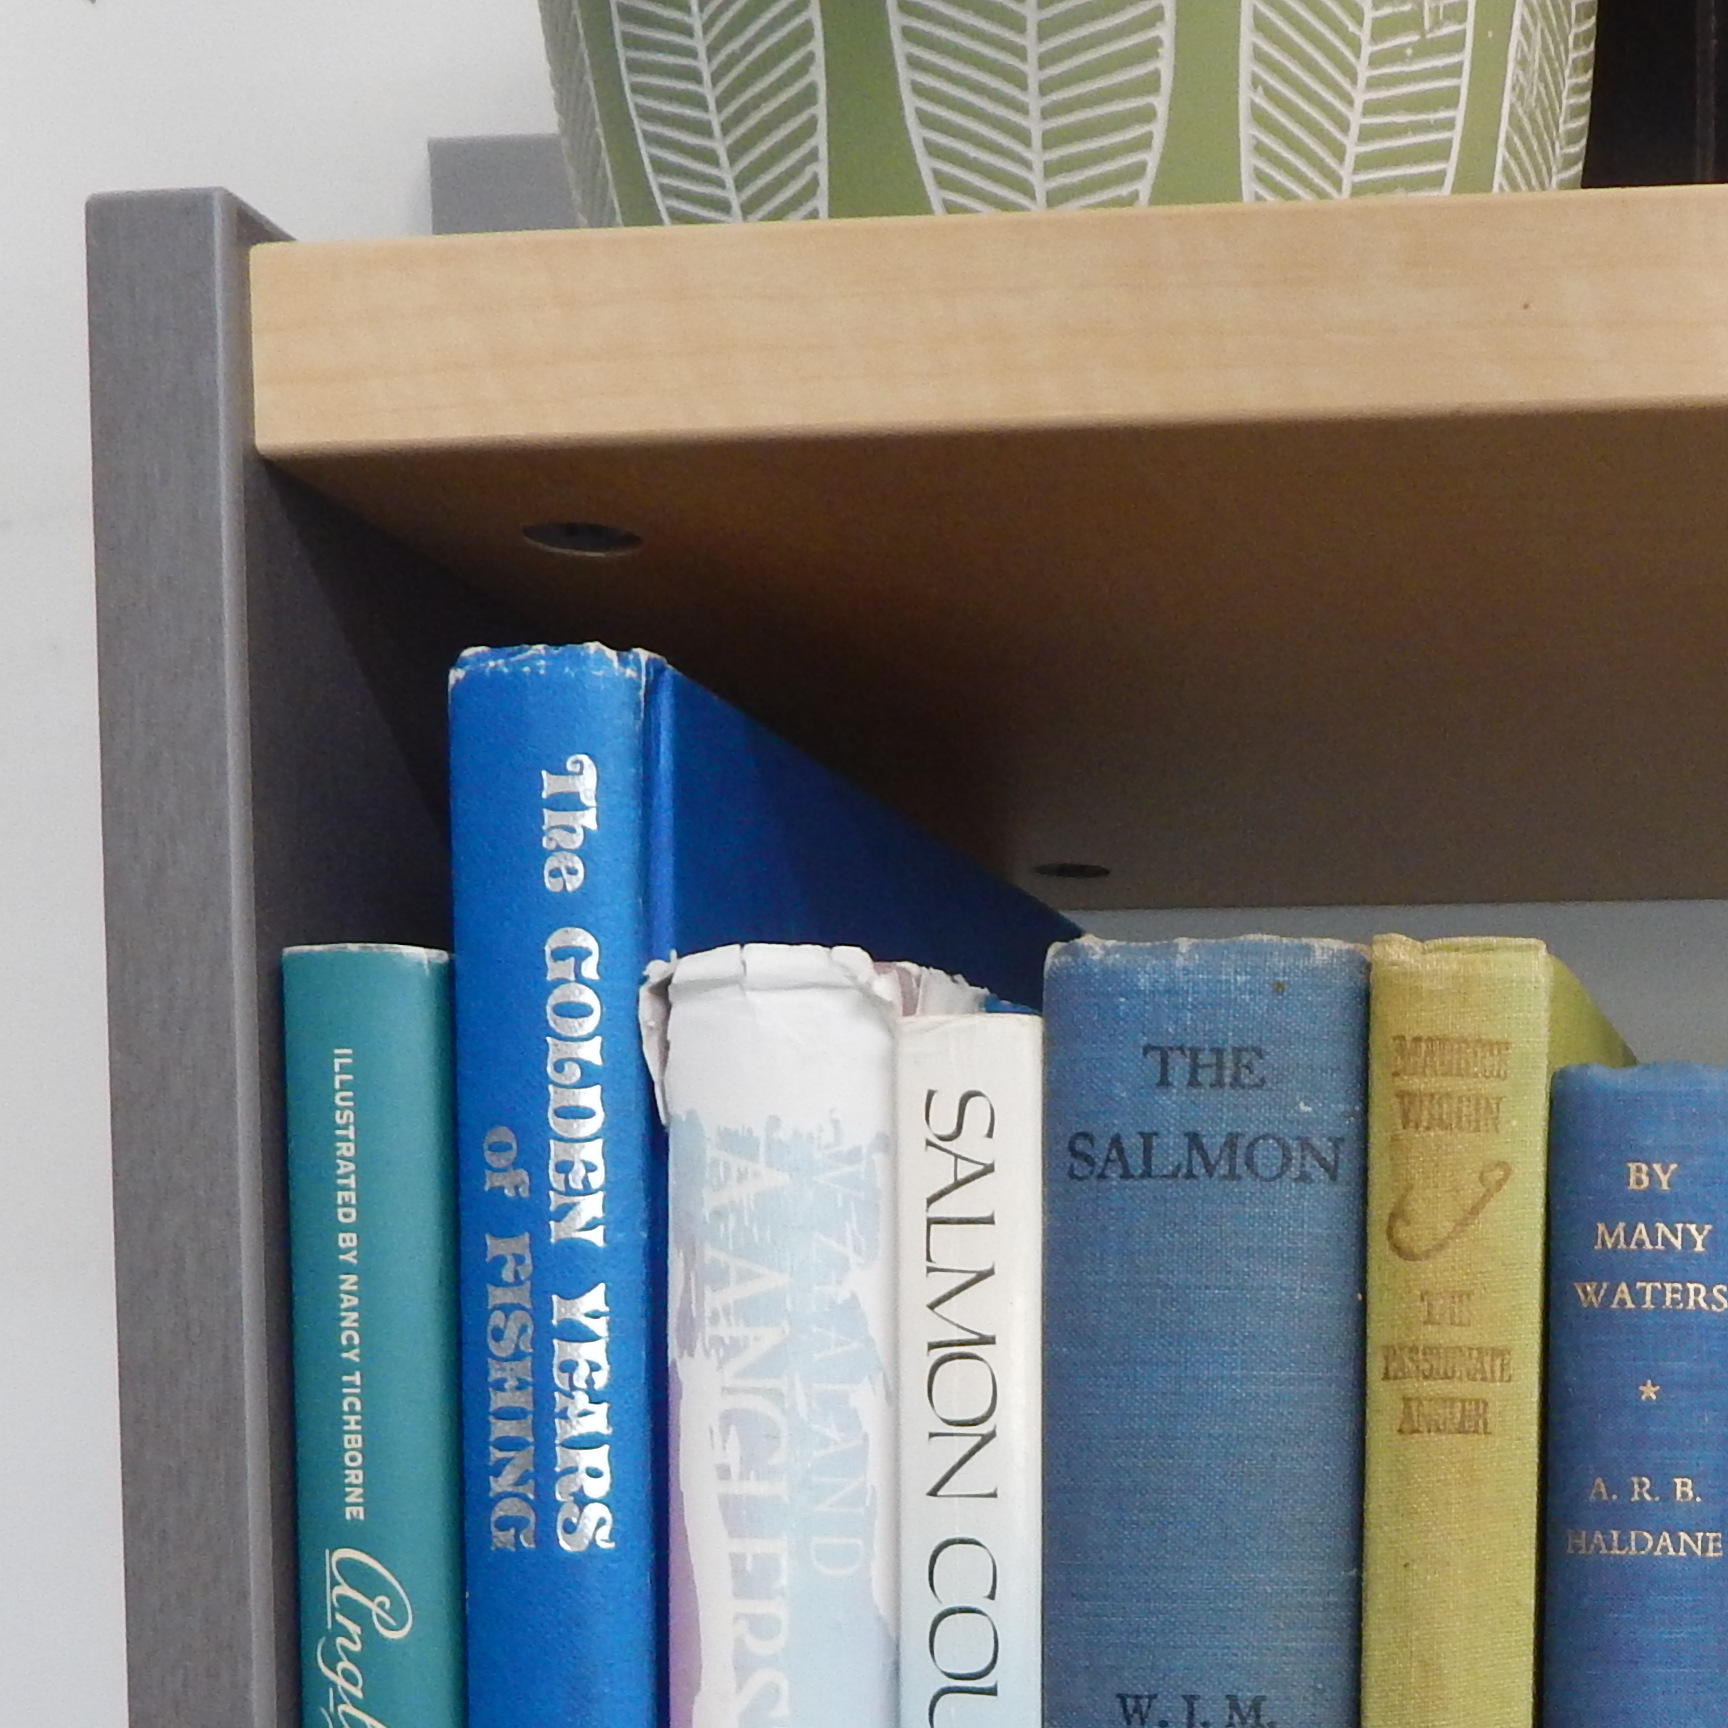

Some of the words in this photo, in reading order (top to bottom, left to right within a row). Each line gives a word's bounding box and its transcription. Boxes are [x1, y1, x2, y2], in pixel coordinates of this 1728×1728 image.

[540, 753, 599, 893] The
[543, 926, 606, 1248] GOLDEN
[1143, 1044, 1266, 1089] THE
[333, 1047, 357, 1224] ILLUSTRATED
[1066, 1131, 1345, 1186] SALMON
[1626, 1161, 1678, 1191] BY
[338, 1232, 359, 1265] BY
[1594, 1222, 1712, 1253] MANY
[339, 1273, 362, 1364] NANCY
[924, 1088, 999, 1498] SALMON
[484, 1231, 537, 1552] FISHING
[551, 1282, 615, 1553] YEARS
[342, 1370, 365, 1521] TICHBORNE
[1587, 1477, 1616, 1502] A.
[1630, 1477, 1660, 1502] R.
[1673, 1477, 1702, 1502] B.
[1566, 1531, 1723, 1558] HALDANE
